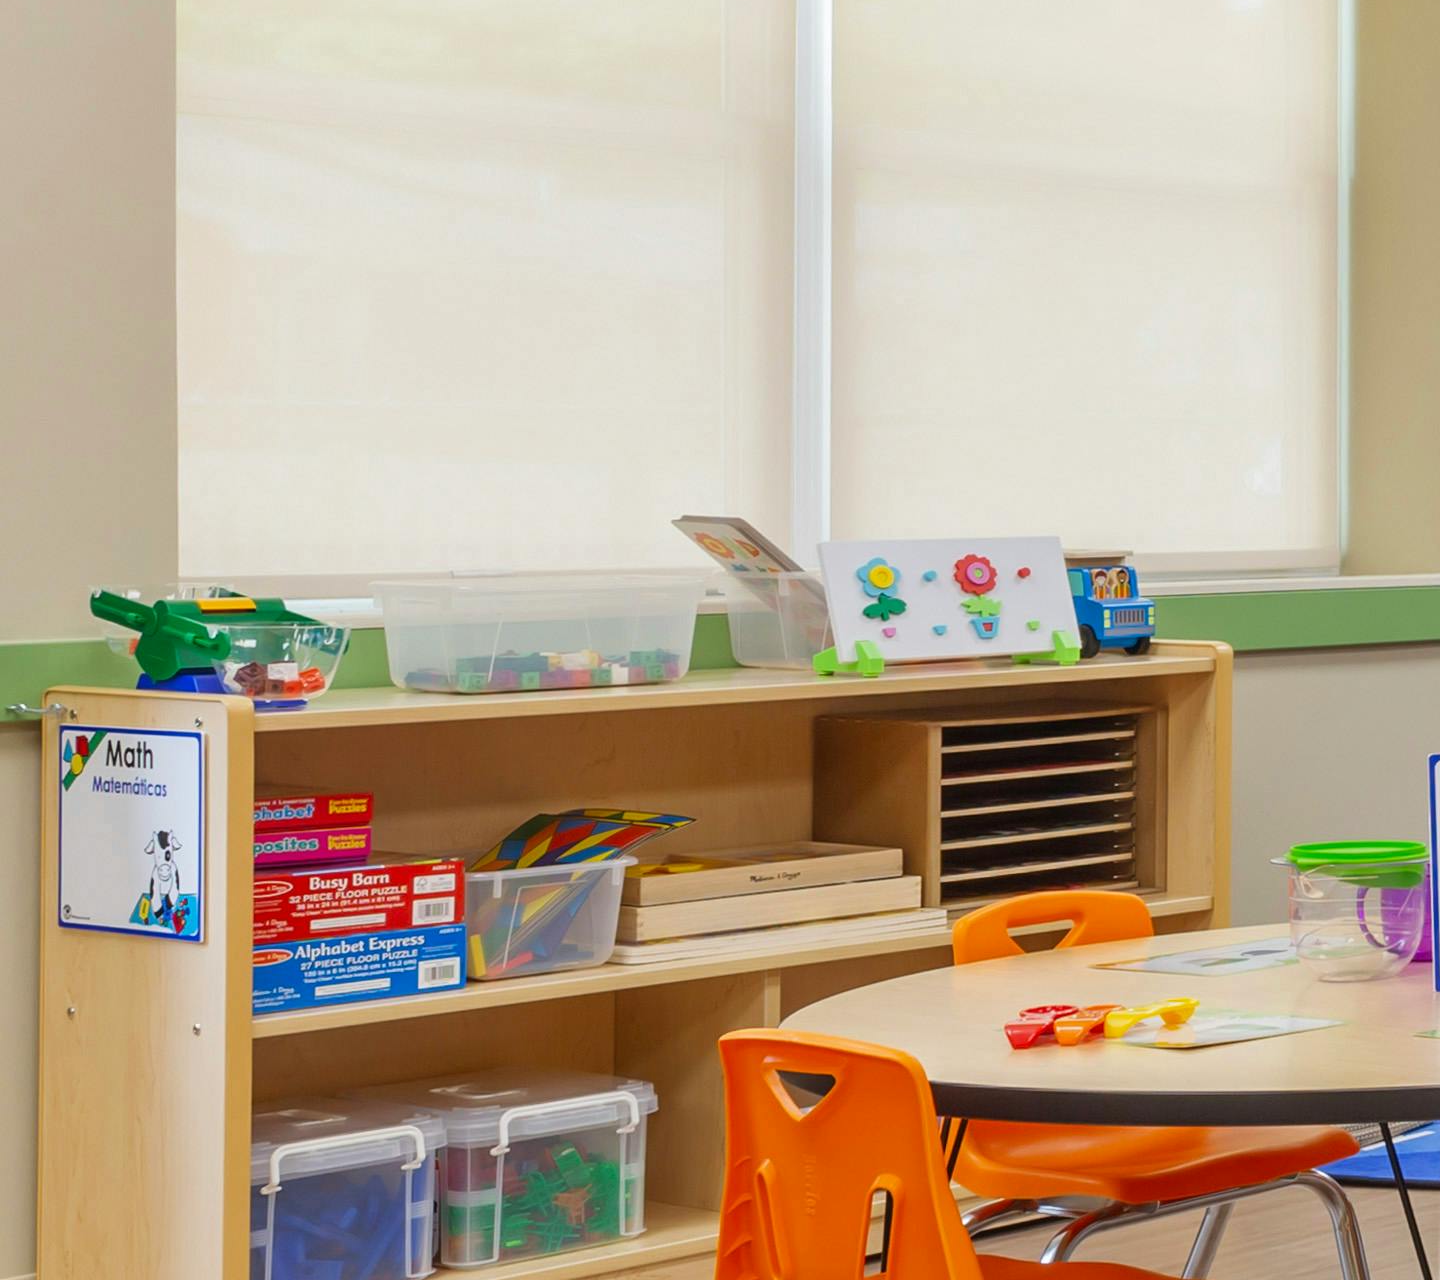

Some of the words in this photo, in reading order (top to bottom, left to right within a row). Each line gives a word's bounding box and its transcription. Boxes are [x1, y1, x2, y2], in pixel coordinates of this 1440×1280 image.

[105, 739, 154, 769] Math
[92, 775, 168, 797] Matemáticas
[309, 877, 349, 892] Busy
[352, 873, 390, 886] Barn
[288, 895, 302, 904] 32
[303, 892, 333, 902] PIECE
[335, 889, 369, 899] FLOOR
[370, 885, 408, 896] PUZZLE
[294, 940, 365, 960] Alphabet
[369, 935, 425, 951] Express
[300, 962, 313, 971] 27
[314, 959, 344, 969] PIECE
[346, 955, 380, 966] FLOOR
[381, 949, 419, 961] PUZZLE
